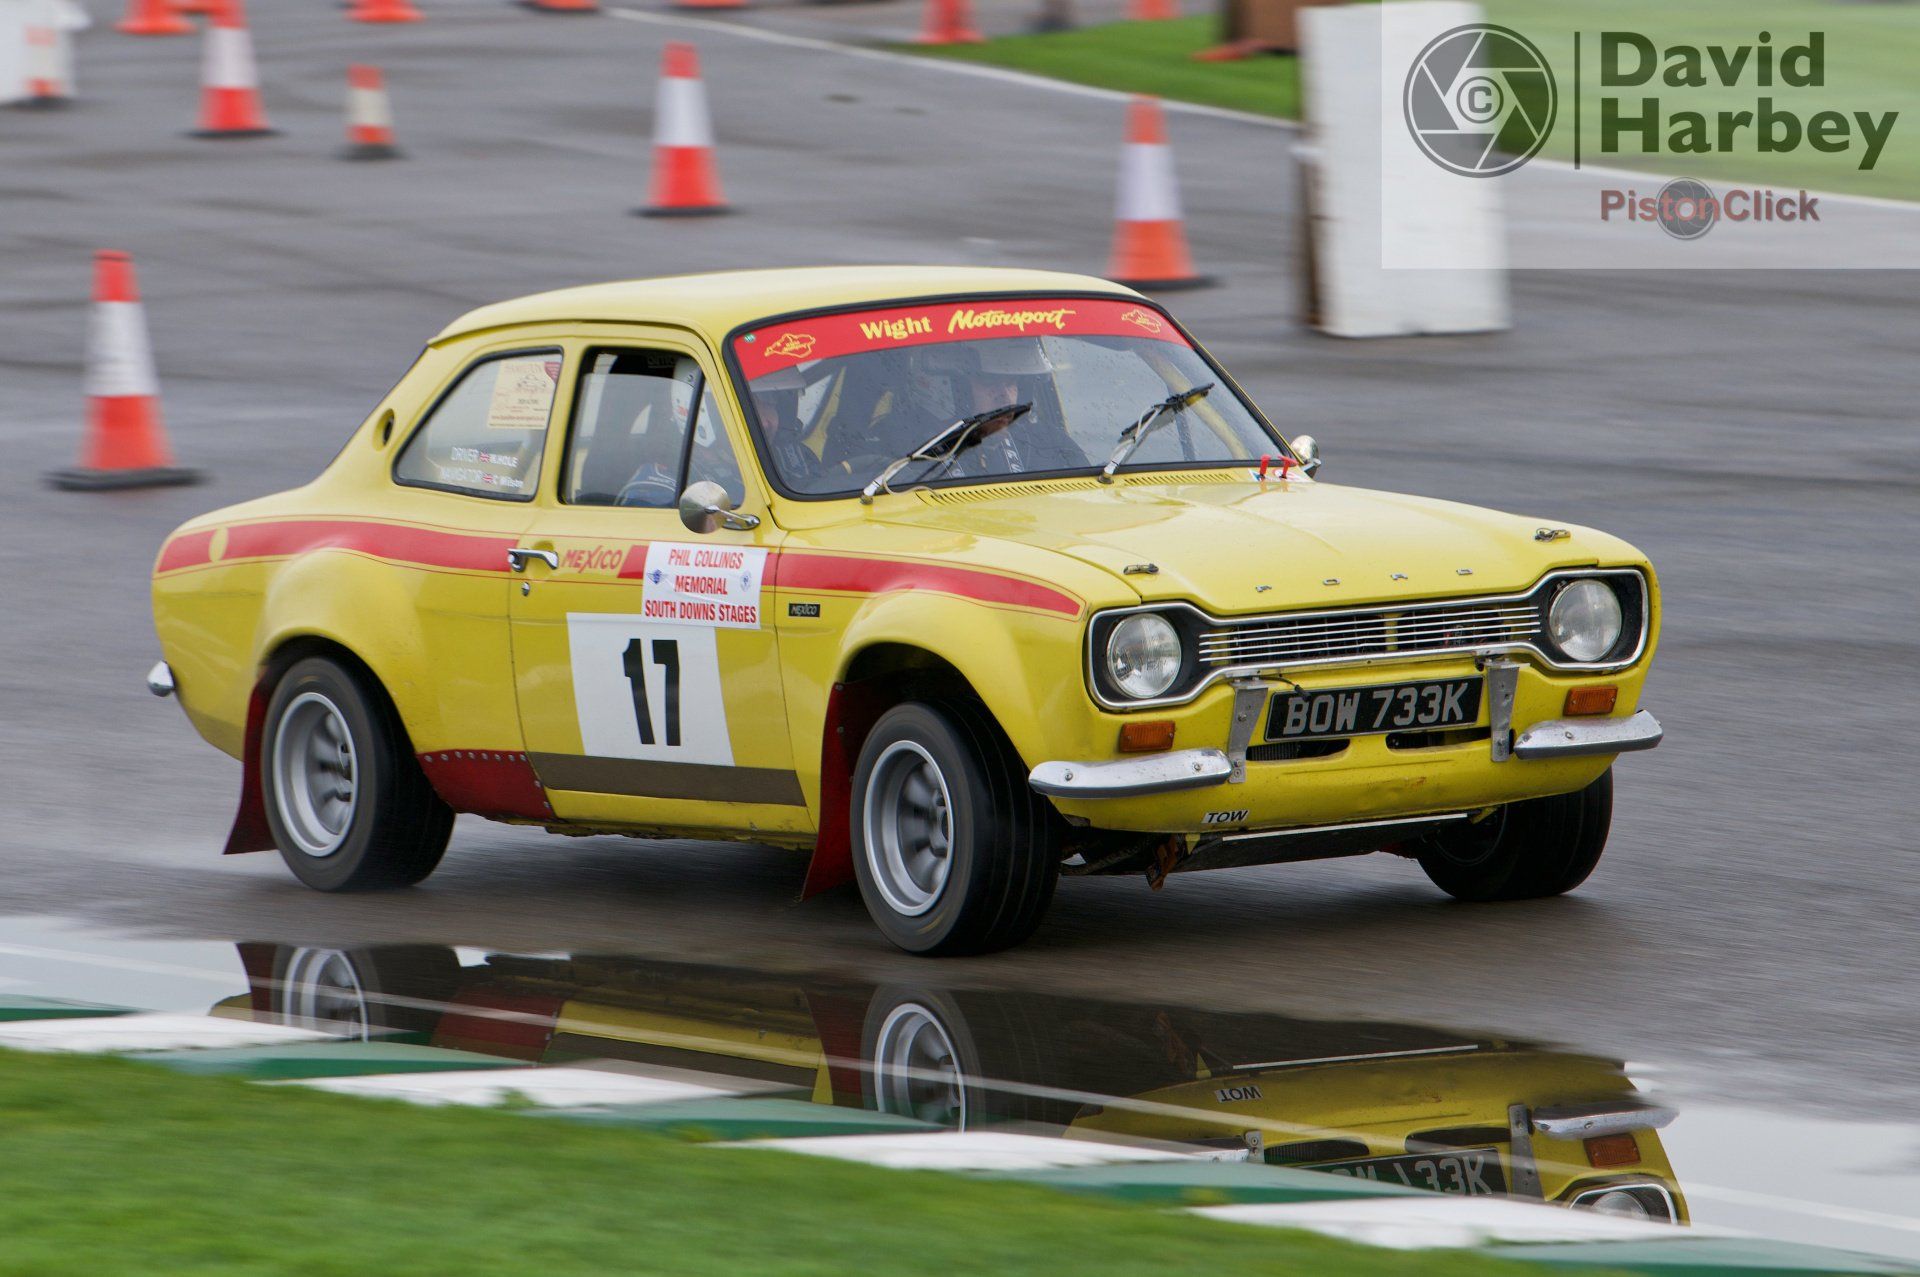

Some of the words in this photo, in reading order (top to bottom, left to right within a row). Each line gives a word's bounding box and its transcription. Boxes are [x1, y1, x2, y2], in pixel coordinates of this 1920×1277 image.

[860, 317, 932, 340] Wight
[948, 308, 1076, 334] Motorsport
[562, 545, 623, 573] MEXICO
[668, 549, 690, 566] PHIL
[695, 552, 744, 569] COLLINGS
[674, 575, 728, 595] MEMORIAL
[645, 600, 676, 618] SOUTH
[679, 603, 715, 621] DOWNS
[719, 606, 757, 623] STAGES
[791, 605, 817, 615] MEXICO
[622, 638, 681, 747] 17
[1284, 693, 1360, 734] BOW
[1372, 683, 1468, 729] 733K
[1207, 810, 1248, 823] TOW
